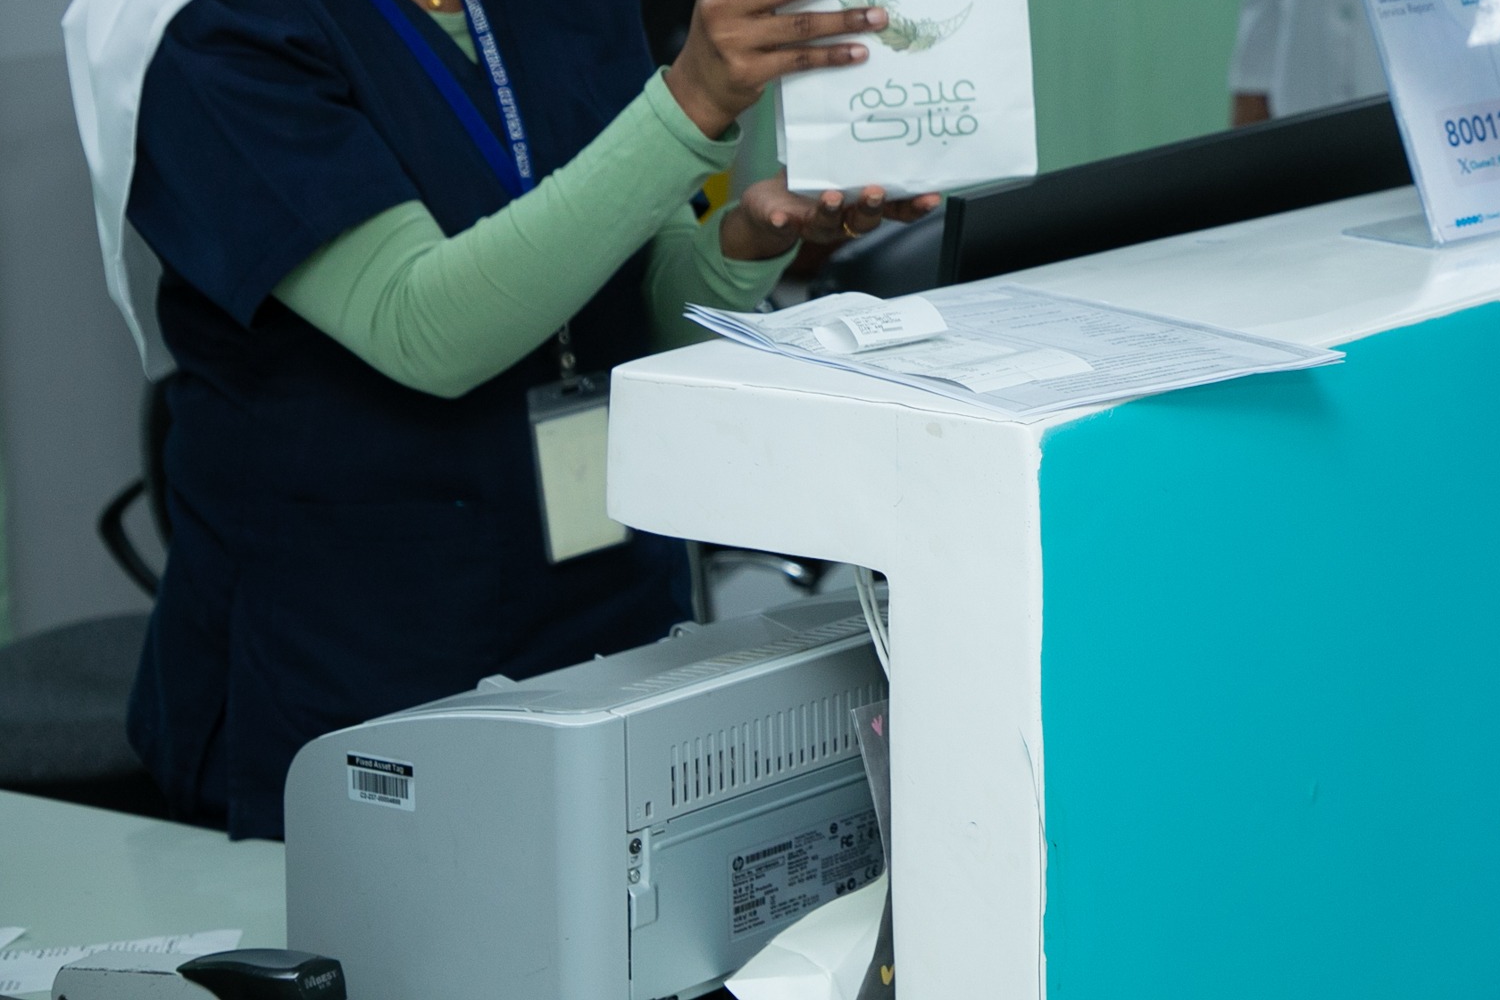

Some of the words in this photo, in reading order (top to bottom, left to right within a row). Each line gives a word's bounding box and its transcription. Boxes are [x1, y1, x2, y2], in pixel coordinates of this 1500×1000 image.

[479, 31, 509, 86] GENERAL
[849, 78, 976, 112] عيدكم
[355, 757, 373, 767] Fixed
[373, 760, 391, 771] Asset
[392, 763, 405, 775] Tag
